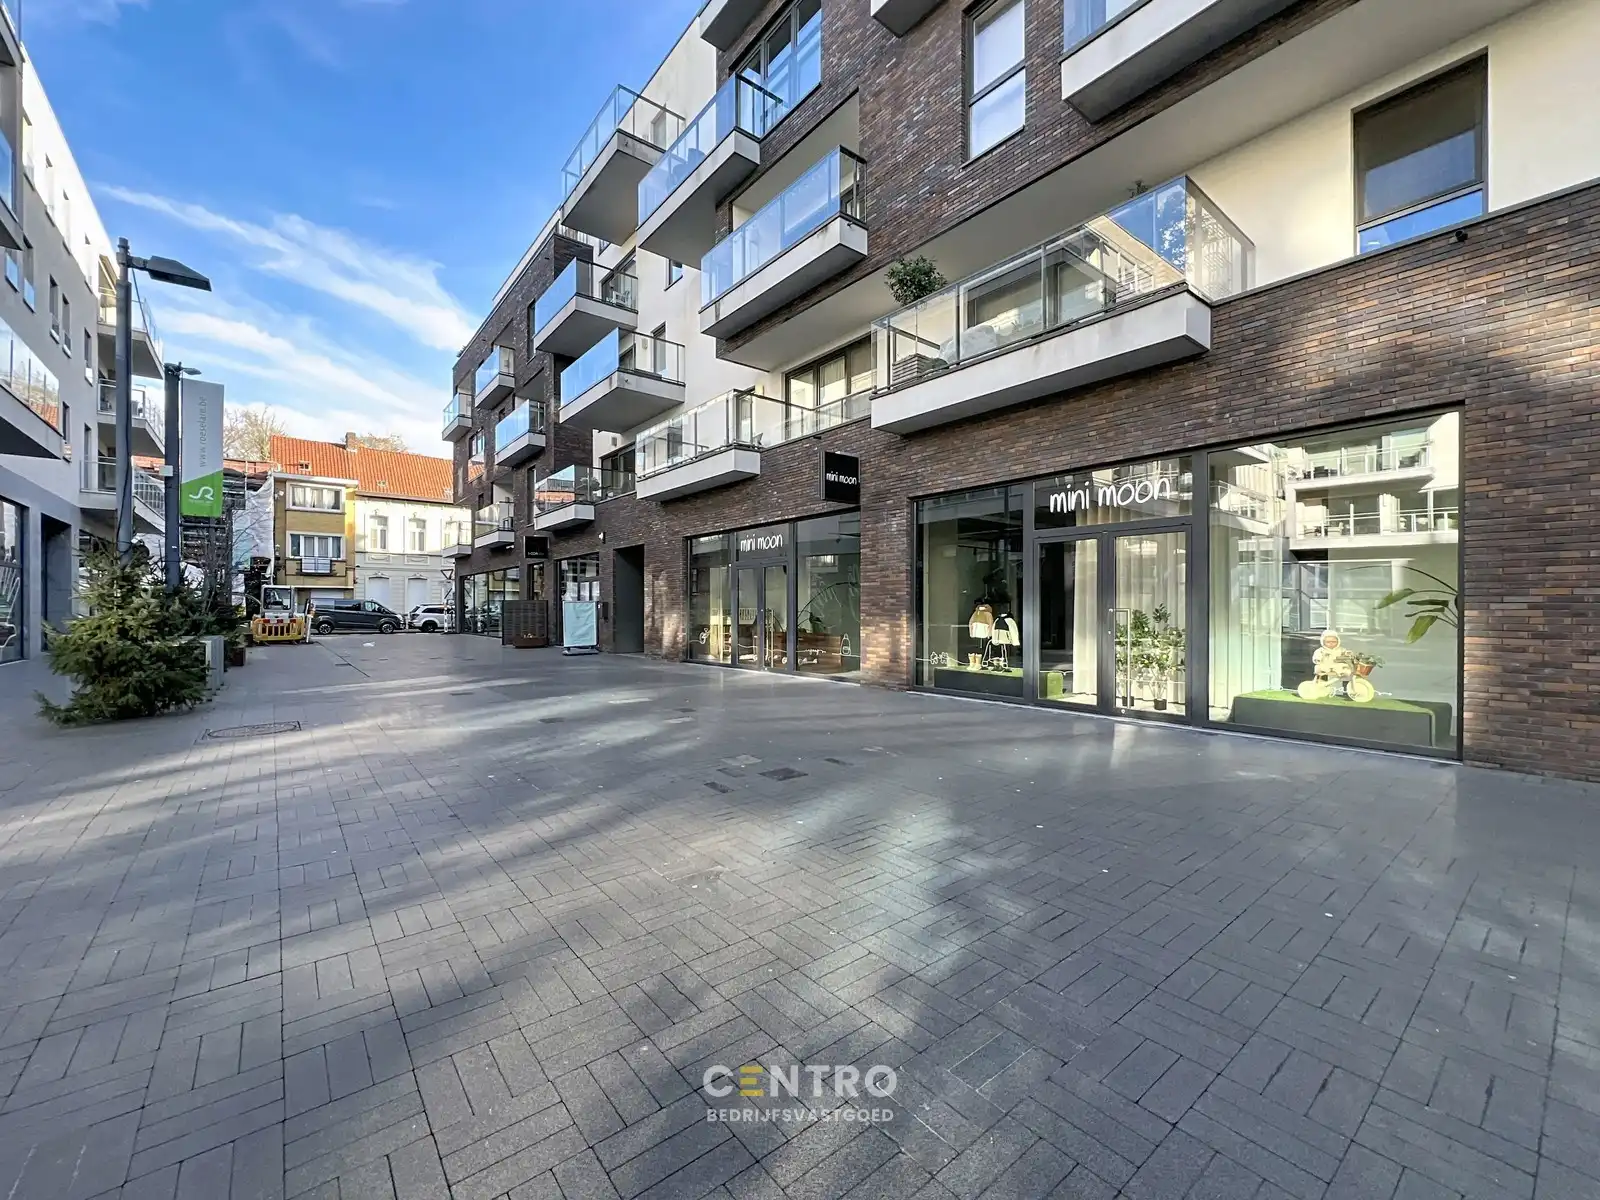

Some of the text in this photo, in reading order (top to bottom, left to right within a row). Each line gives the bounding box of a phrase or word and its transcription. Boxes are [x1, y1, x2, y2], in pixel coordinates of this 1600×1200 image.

[826, 470, 857, 485] mini moon
[1049, 478, 1170, 513] mini moon
[740, 533, 783, 552] mini moon
